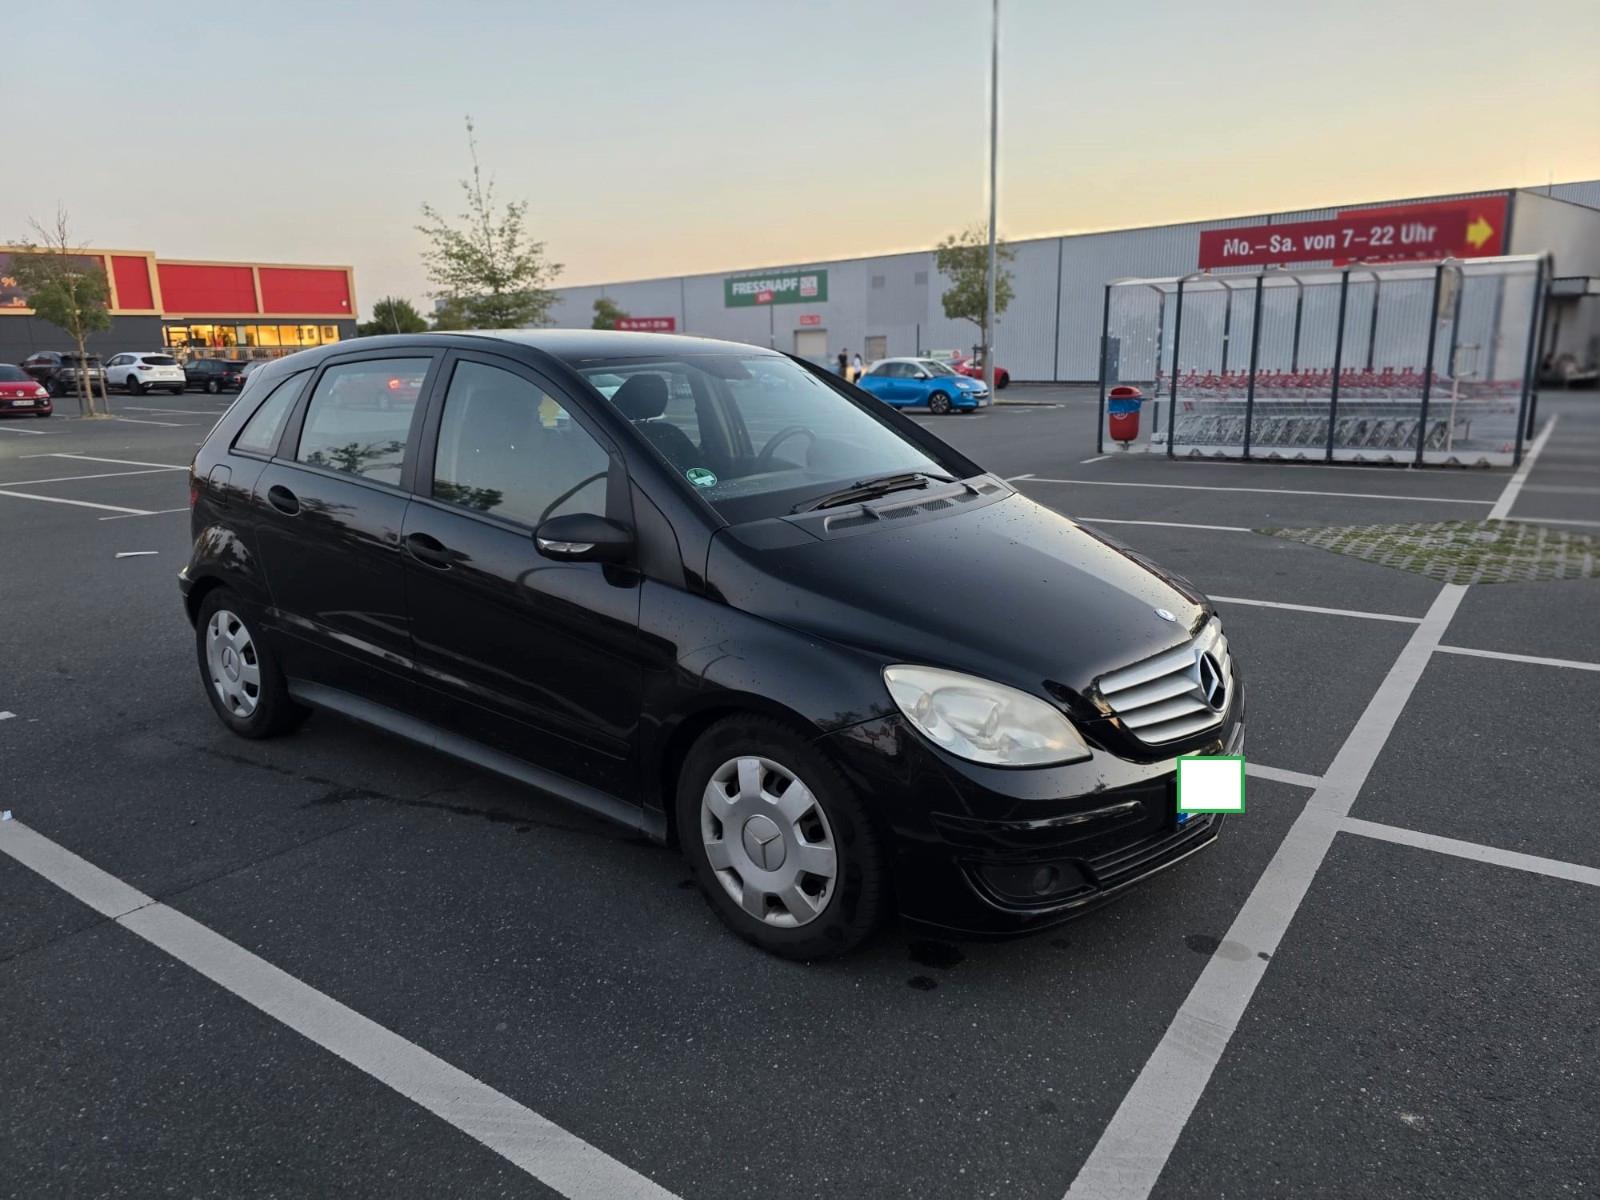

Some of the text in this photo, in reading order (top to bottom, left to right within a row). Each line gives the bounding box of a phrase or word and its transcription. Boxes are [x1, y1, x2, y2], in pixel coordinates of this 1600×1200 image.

[1304, 234, 1336, 250] von
[1401, 222, 1437, 244] Uhr
[732, 277, 799, 296] FRESSNAPF
